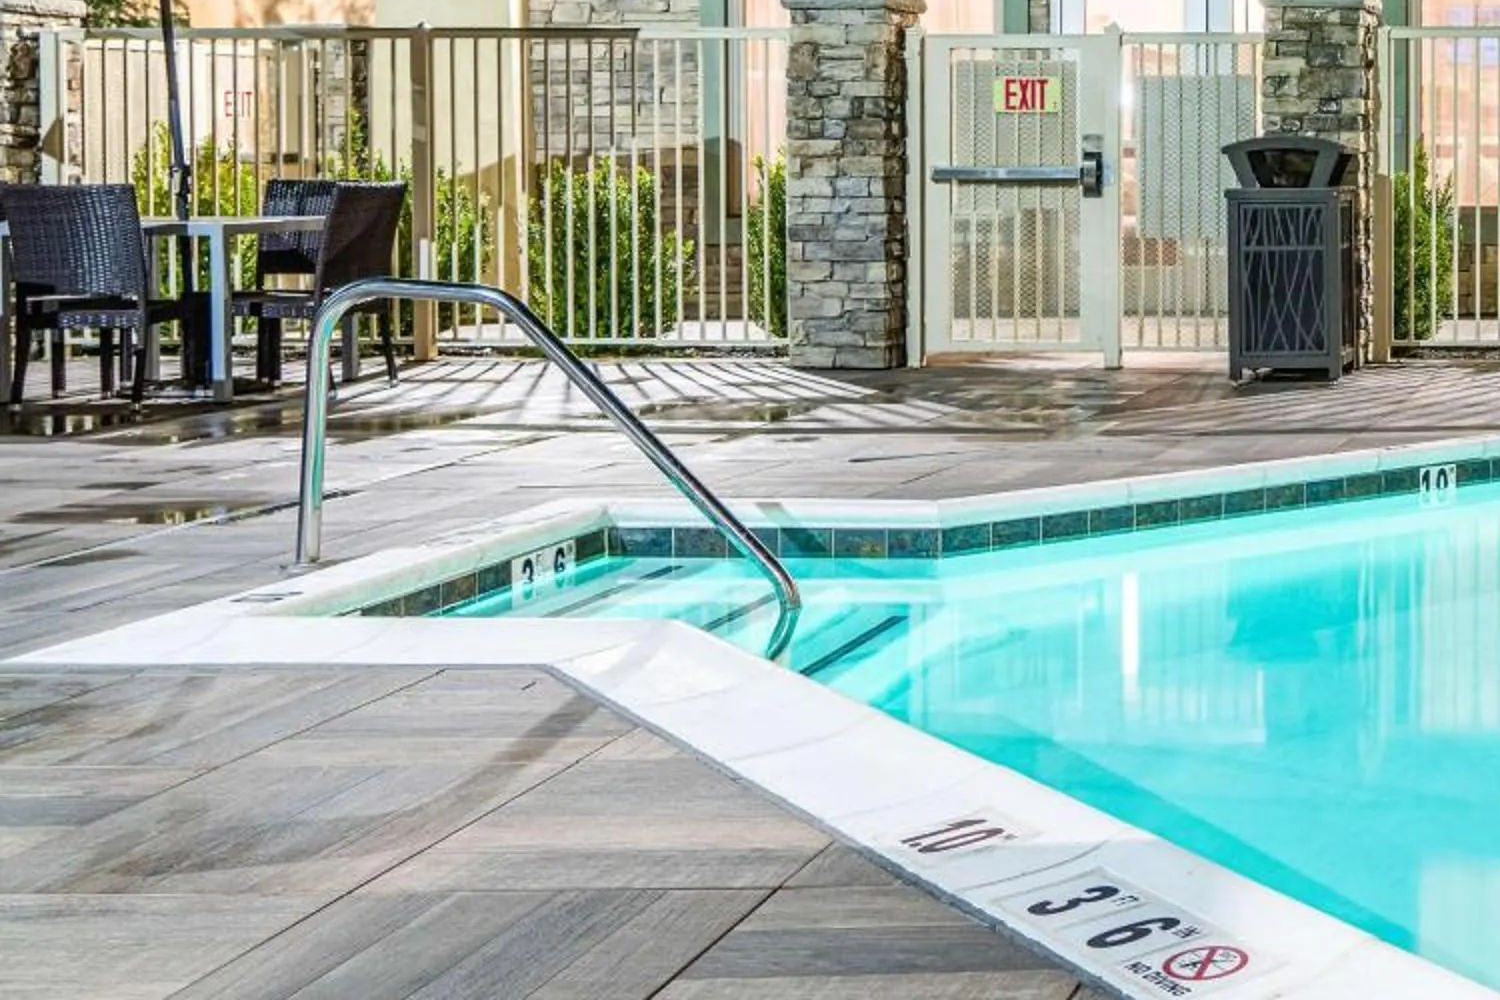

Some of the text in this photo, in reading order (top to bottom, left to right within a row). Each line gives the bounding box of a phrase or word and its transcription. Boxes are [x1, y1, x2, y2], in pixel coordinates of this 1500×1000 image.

[224, 91, 253, 118] EIT
[1005, 79, 1048, 110] EXIT
[1027, 885, 1120, 915] 3
[1086, 917, 1181, 949] 6
